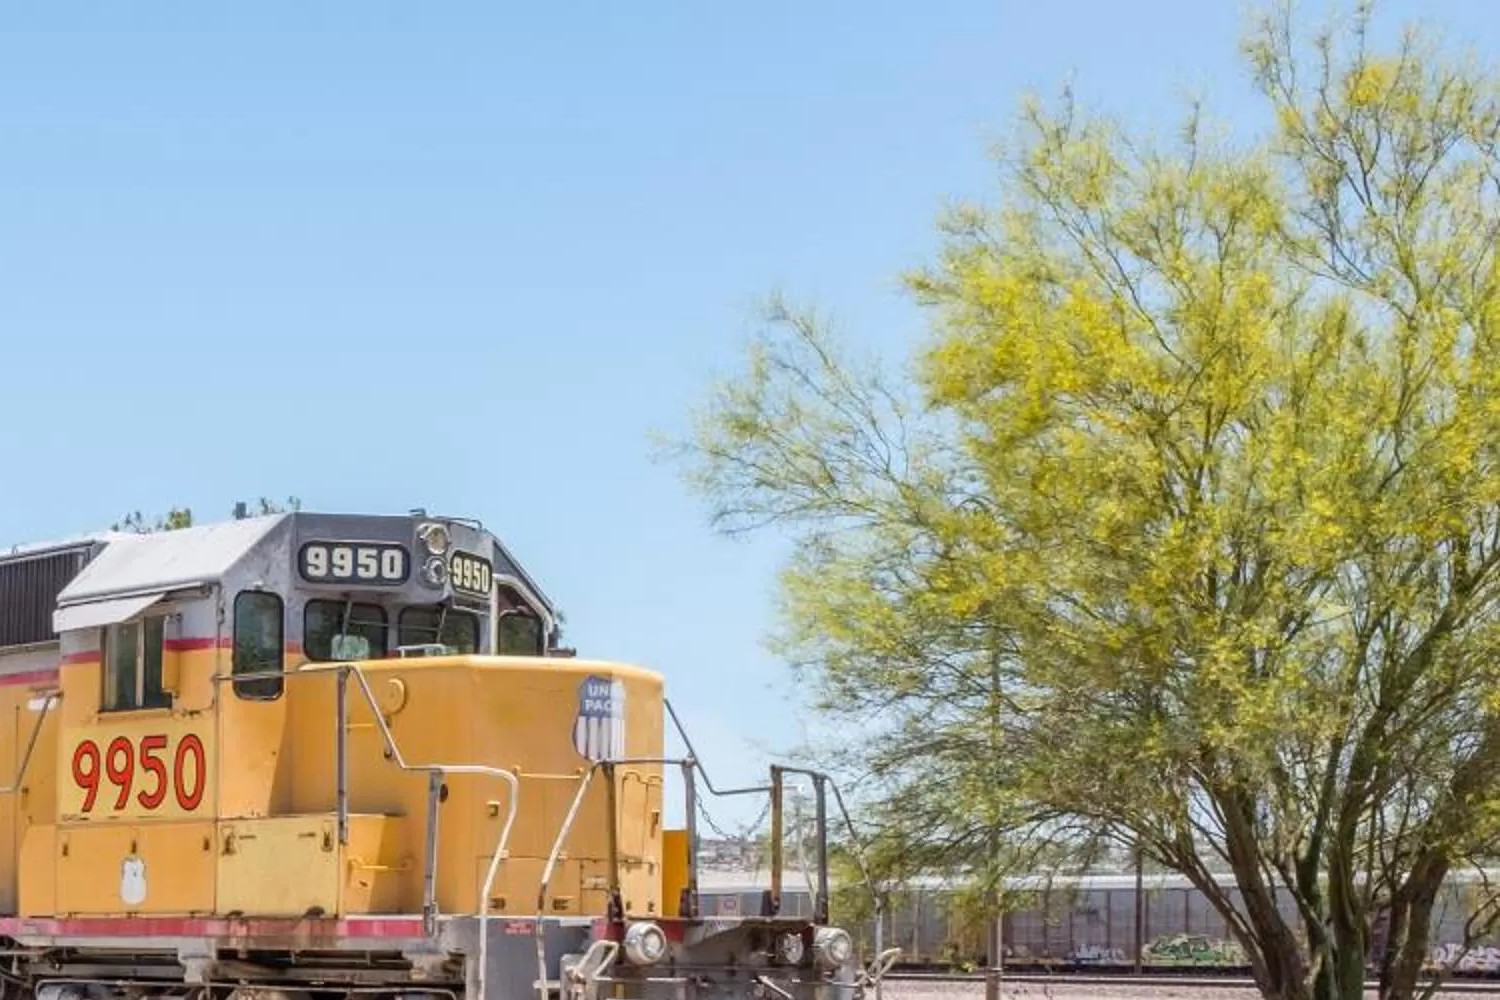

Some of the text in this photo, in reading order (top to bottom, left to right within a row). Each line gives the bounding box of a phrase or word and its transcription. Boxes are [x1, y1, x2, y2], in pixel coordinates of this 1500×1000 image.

[306, 546, 403, 579] 9950
[452, 556, 489, 593] 9950
[72, 733, 206, 813] 9950
